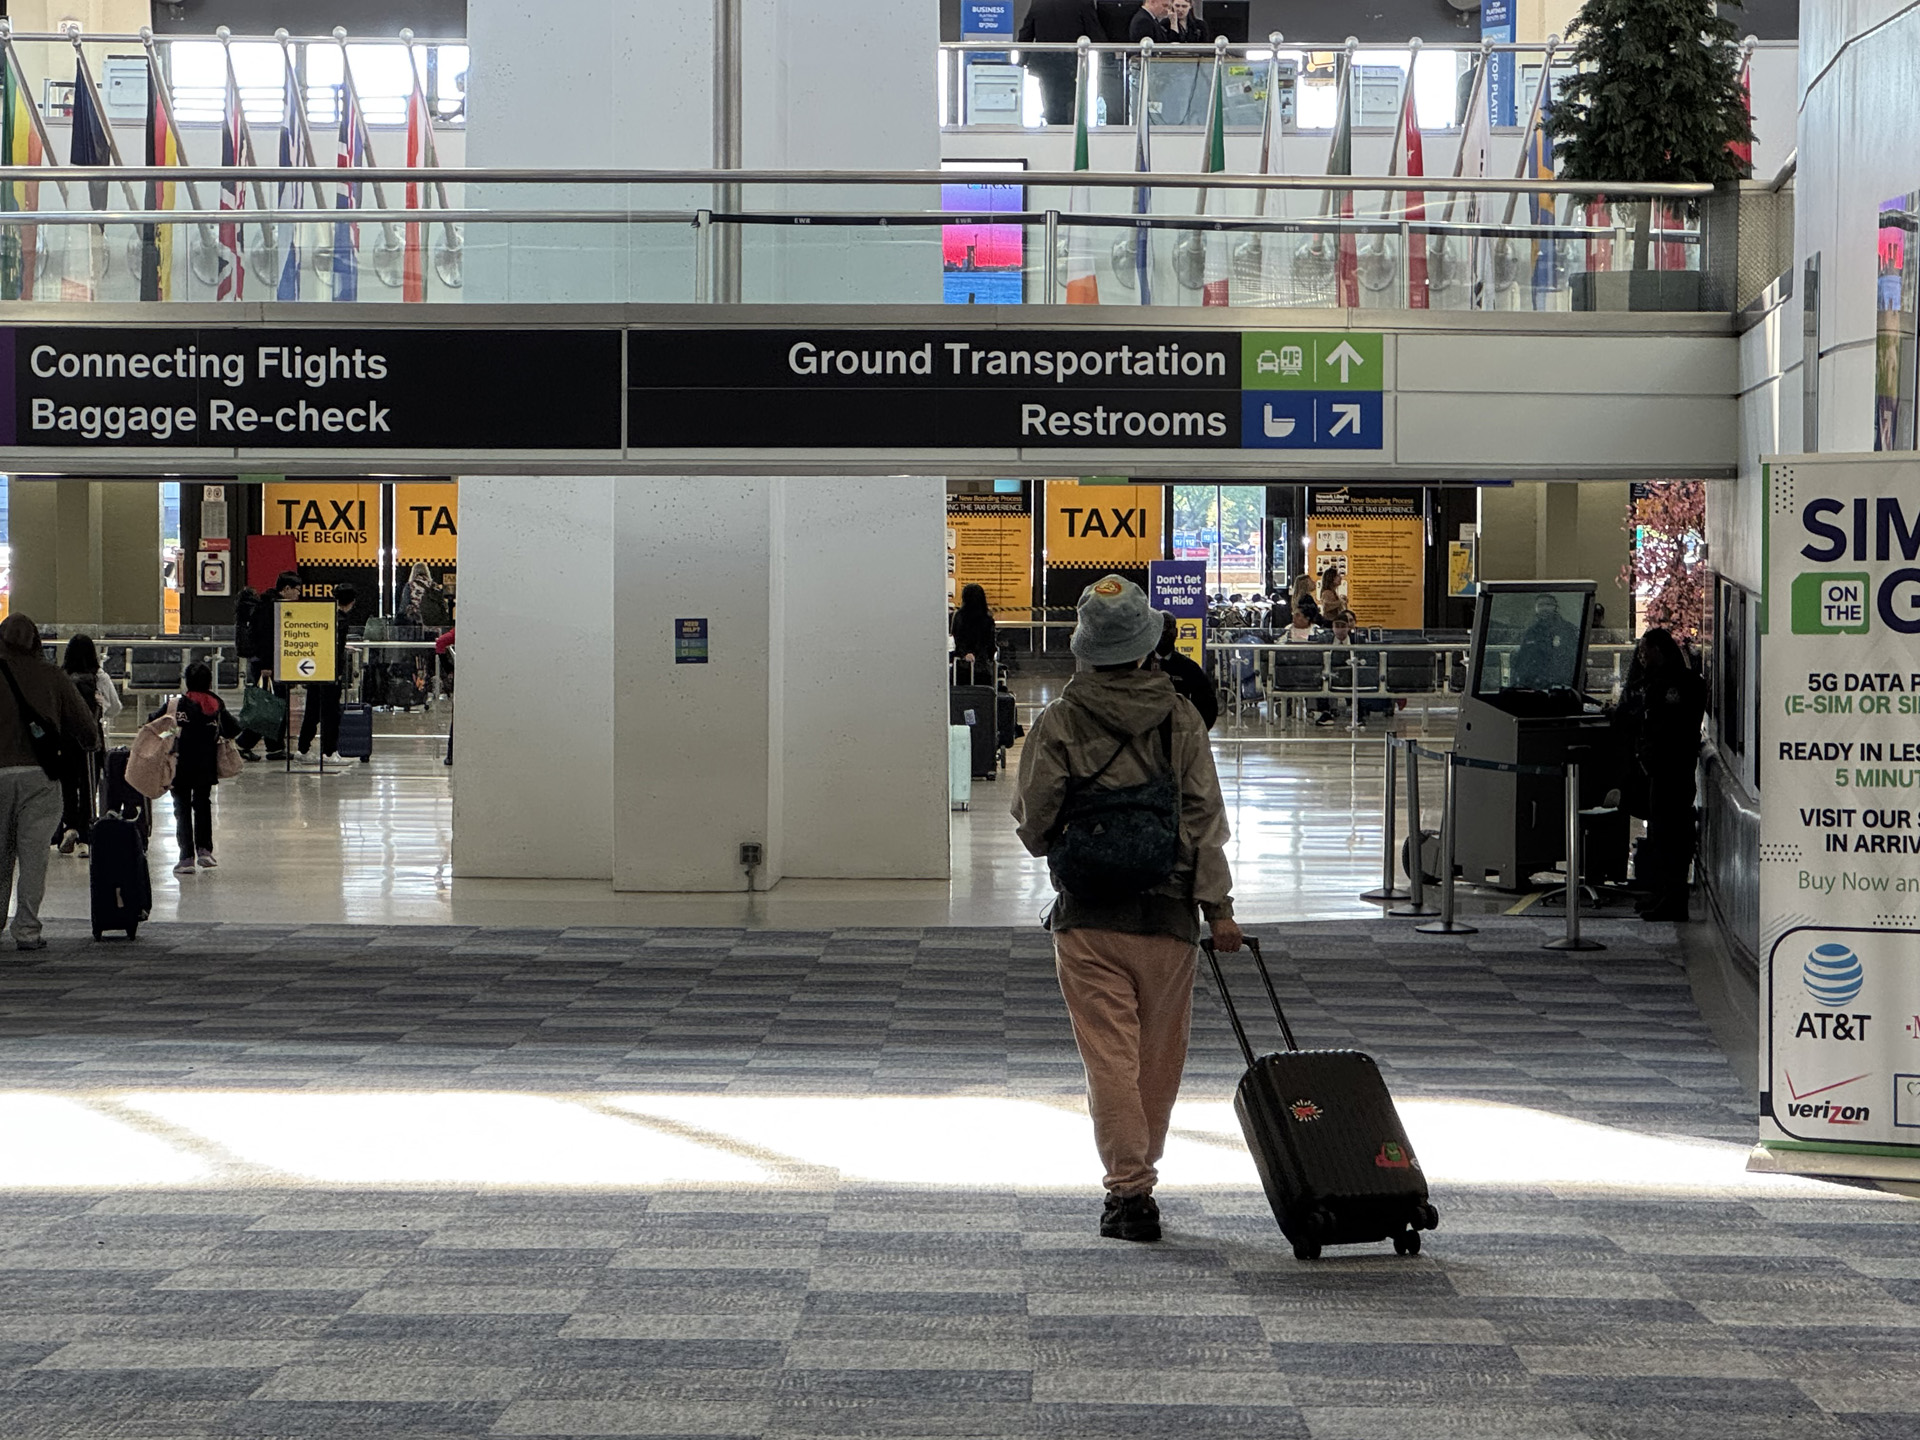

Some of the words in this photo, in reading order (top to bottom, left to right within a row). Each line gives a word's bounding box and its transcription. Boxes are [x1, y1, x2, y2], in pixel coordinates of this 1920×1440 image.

[1491, 53, 1499, 82] TOP
[30, 345, 244, 386] Connecting
[258, 346, 388, 388] Flights
[788, 342, 932, 375] Ground
[944, 342, 1227, 383] Transportation
[31, 399, 197, 439] Baggage
[209, 399, 391, 433] Re-check
[1020, 403, 1228, 436] Restrooms
[960, 503, 973, 511] THE
[973, 495, 1000, 504] Boarding
[1365, 497, 1392, 506] Boarding
[277, 499, 366, 531] TAXI
[1315, 505, 1351, 513] IMPROVING
[1060, 508, 1146, 538] TAXI
[1800, 497, 1920, 563] SIM
[314, 531, 368, 544] BEGINS
[1156, 574, 1182, 585] Don't
[1184, 574, 1202, 585] Get
[302, 584, 339, 598] HER
[1156, 585, 1185, 595] Taken
[1187, 585, 1202, 595] for
[1828, 586, 1858, 603] ON
[1163, 597, 1170, 606] a
[1172, 596, 1194, 606] Ride
[1824, 604, 1862, 621] THE
[283, 621, 329, 630] Connecting
[283, 630, 310, 640] Flights
[283, 640, 319, 649] Baggage
[283, 649, 316, 657] Recheck
[1808, 673, 1838, 692] 5G
[1844, 673, 1904, 692] DATA
[1784, 695, 1852, 716] (E-SIM
[1858, 695, 1892, 714] OR
[1898, 695, 1920, 714] SI
[1779, 742, 1854, 761] READY
[1860, 743, 1883, 761] IN
[1835, 768, 1849, 787] 5
[1799, 808, 1857, 828] VISIT
[1862, 809, 1911, 829] OUR
[1825, 834, 1847, 852] IN
[1798, 870, 1836, 894] Buy
[1842, 871, 1890, 892] Now
[1795, 1012, 1872, 1041] AT&T
[1787, 1099, 1870, 1124] verizon
